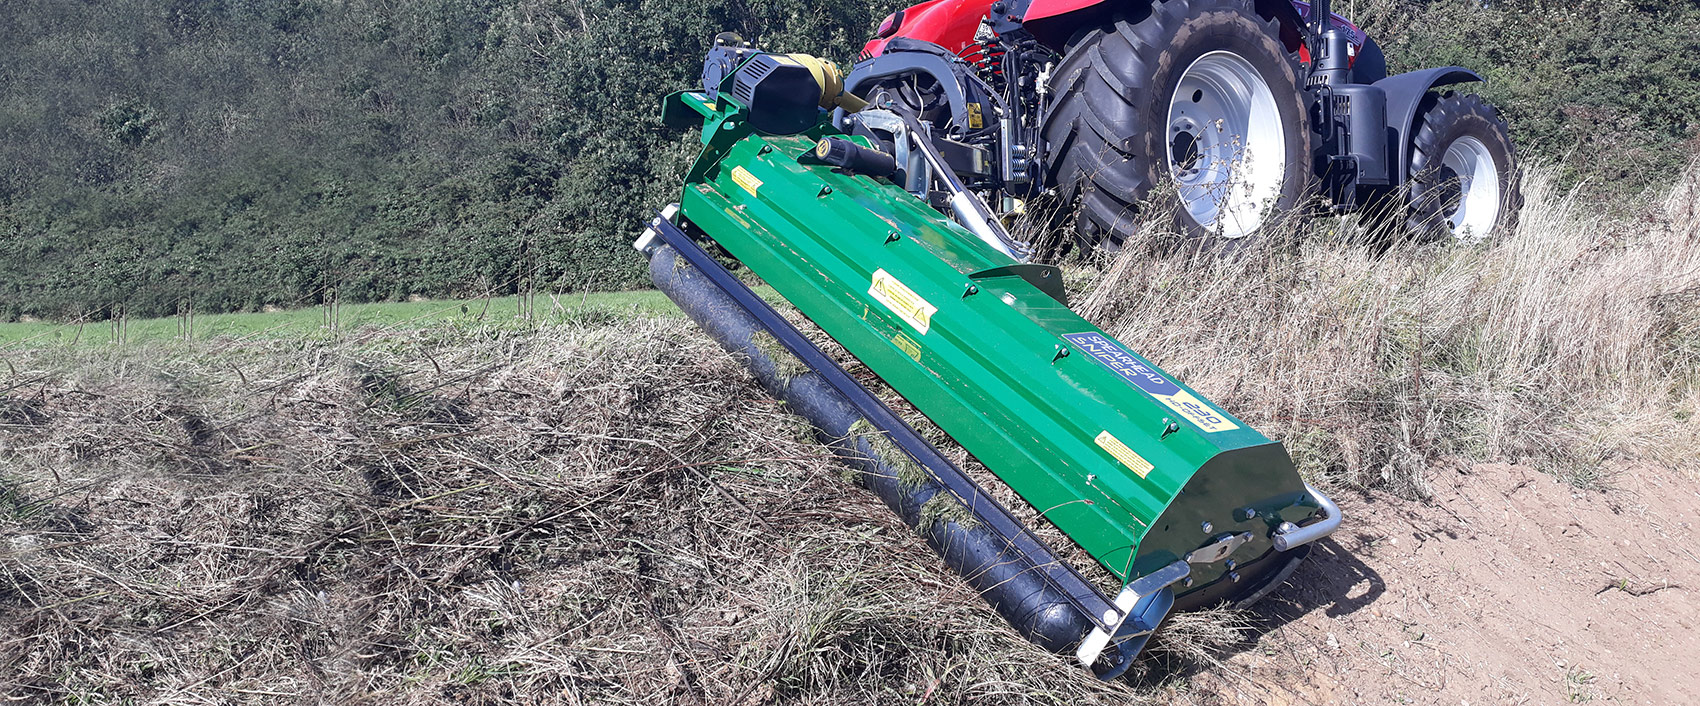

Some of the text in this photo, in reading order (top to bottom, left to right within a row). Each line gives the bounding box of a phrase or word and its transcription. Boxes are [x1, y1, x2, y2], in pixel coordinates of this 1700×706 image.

[1072, 336, 1138, 377] SNIPER
[1087, 335, 1164, 385] SPEARHEAD
[1182, 401, 1222, 424] 230
